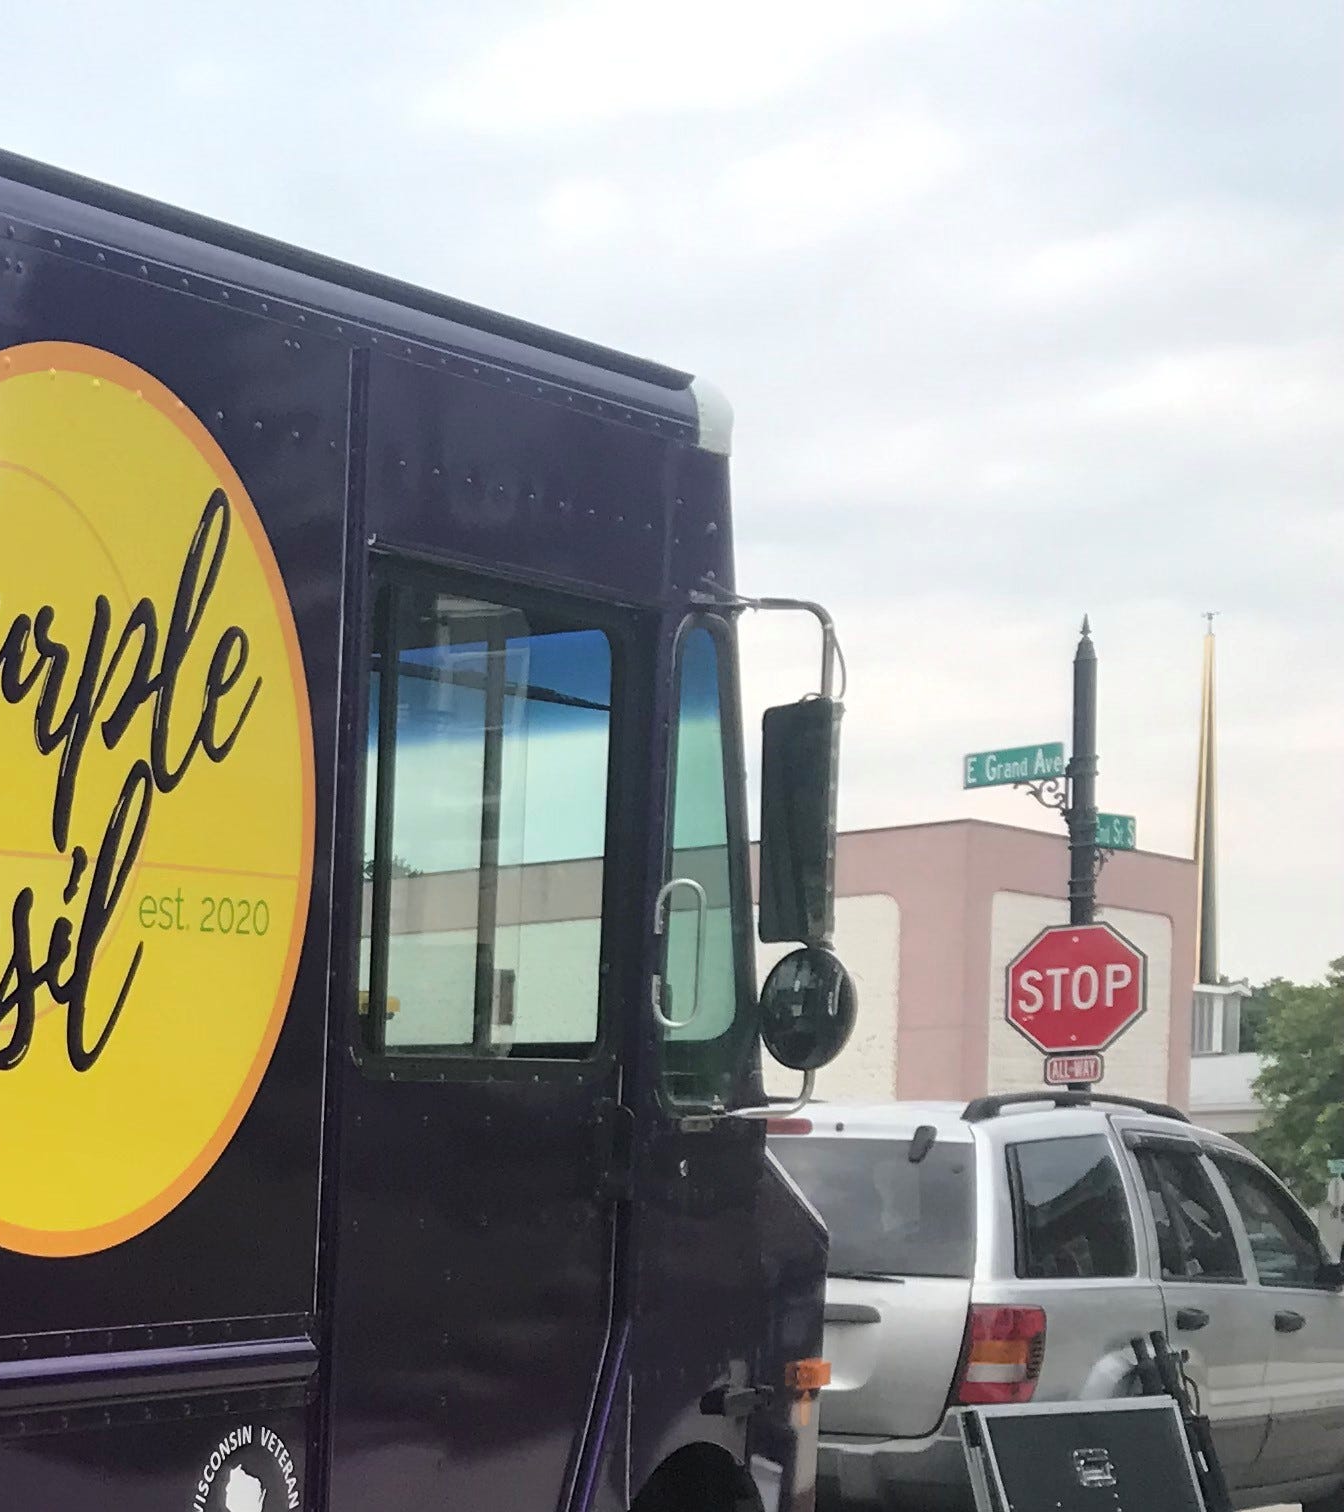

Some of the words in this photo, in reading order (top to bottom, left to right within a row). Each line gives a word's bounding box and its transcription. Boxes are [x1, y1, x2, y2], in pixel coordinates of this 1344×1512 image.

[967, 757, 977, 784] E
[984, 754, 1028, 781] Grand
[1033, 747, 1063, 775] Ave
[138, 887, 190, 930] est.
[199, 896, 270, 936] 2020
[1018, 963, 1132, 1014] STOP
[260, 1426, 300, 1510] VETERAN
